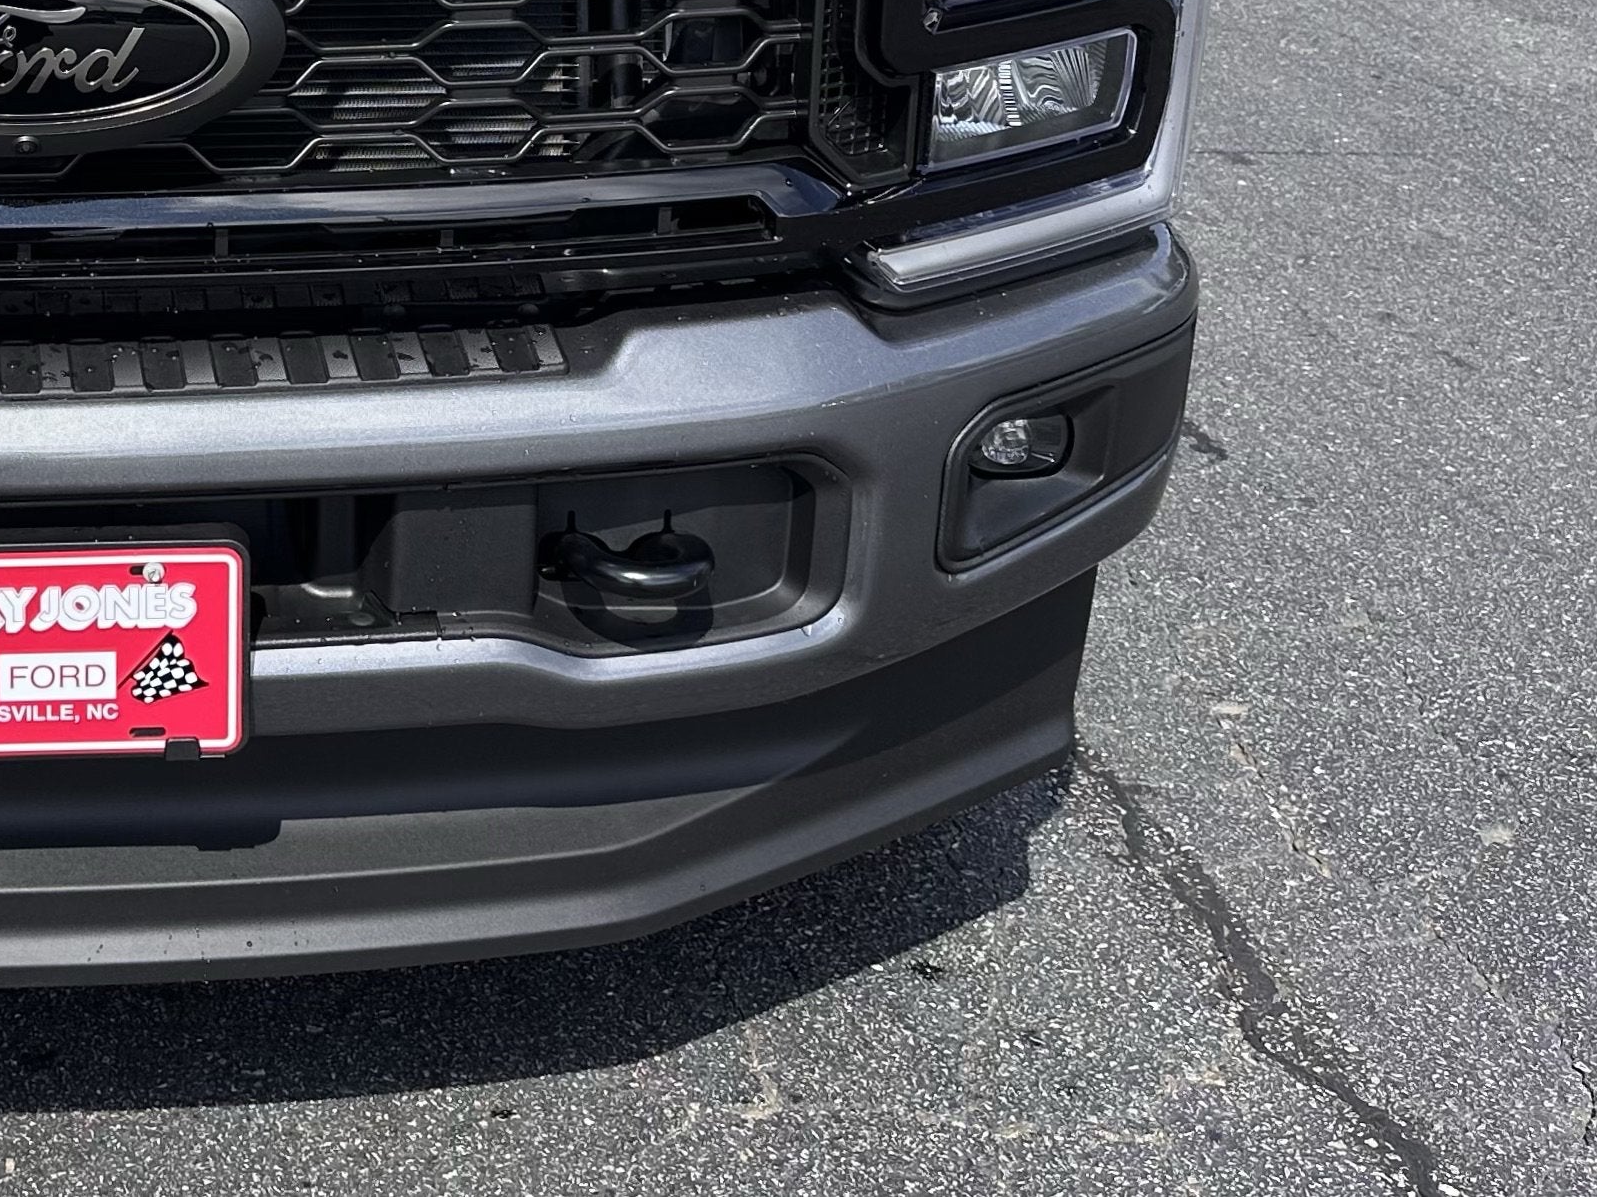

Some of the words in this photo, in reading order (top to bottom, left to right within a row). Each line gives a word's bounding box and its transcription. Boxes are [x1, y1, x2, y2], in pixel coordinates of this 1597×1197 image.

[29, 583, 198, 633] JONES
[9, 663, 107, 690] FORD
[86, 702, 120, 721] NC
